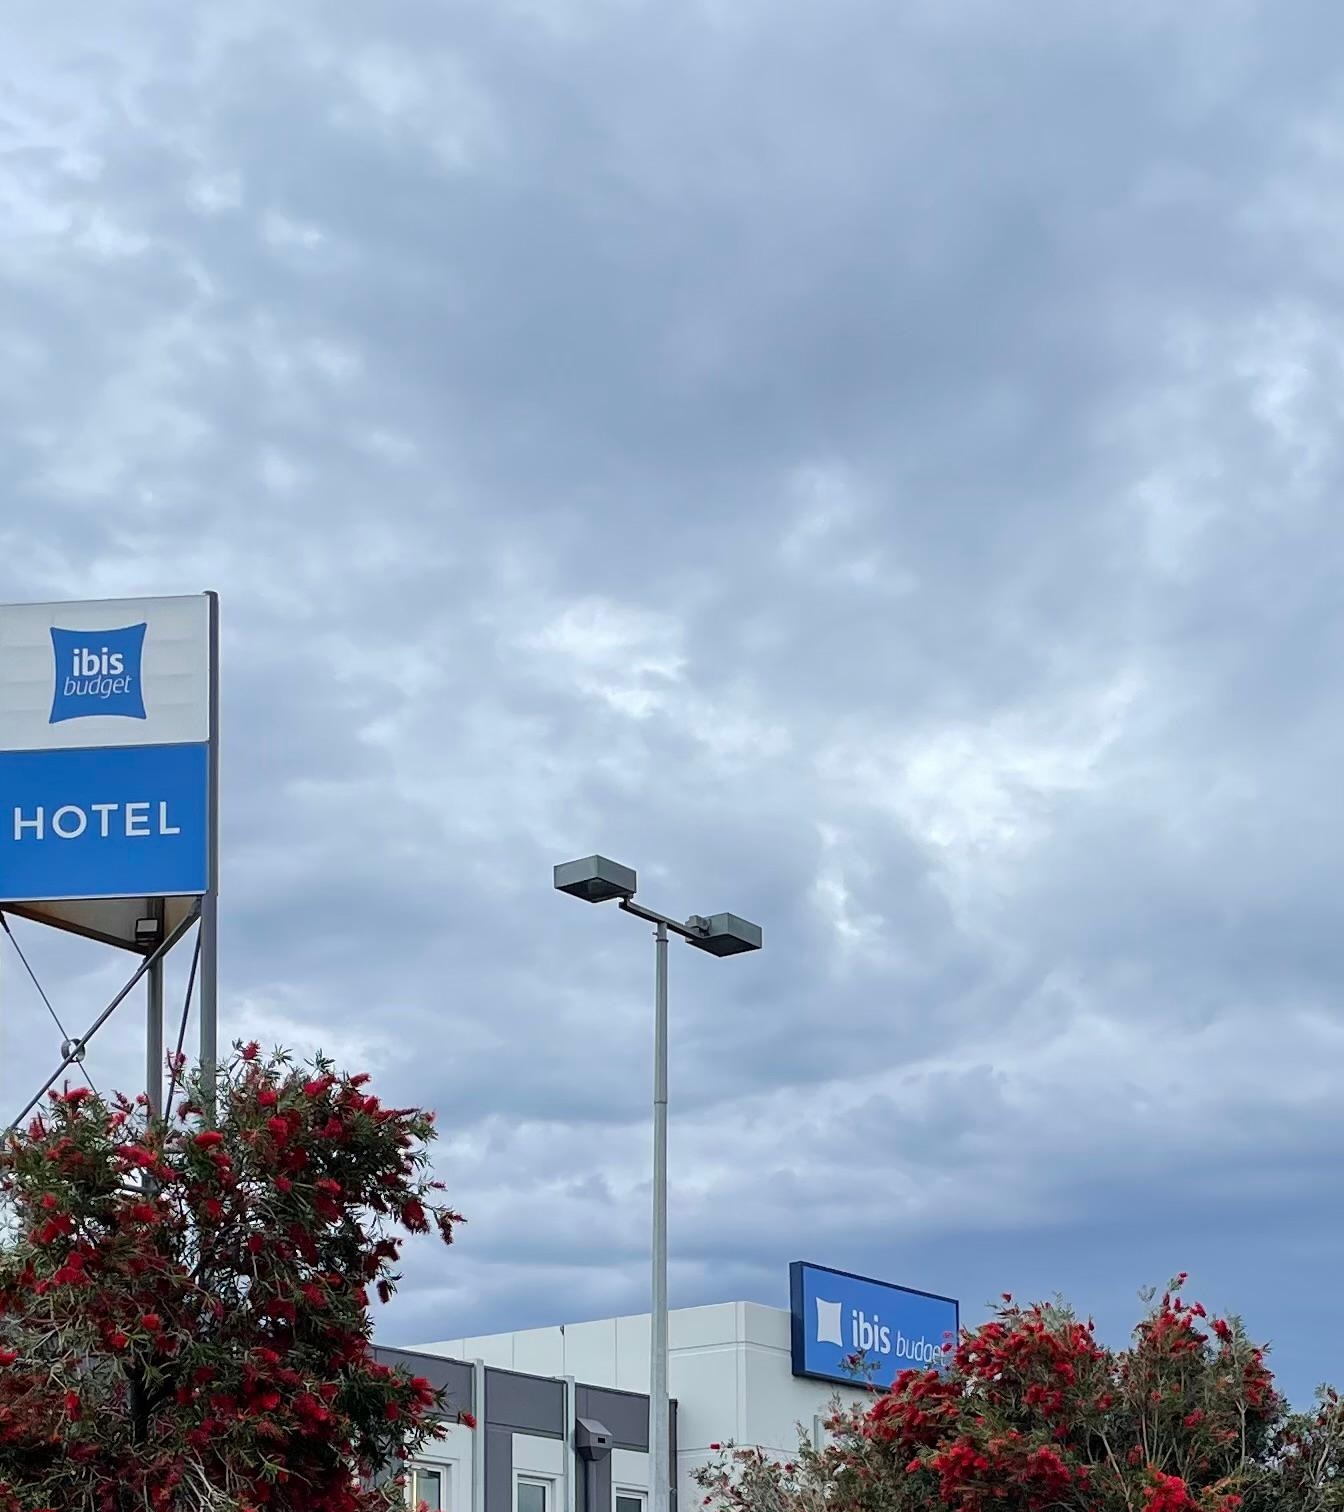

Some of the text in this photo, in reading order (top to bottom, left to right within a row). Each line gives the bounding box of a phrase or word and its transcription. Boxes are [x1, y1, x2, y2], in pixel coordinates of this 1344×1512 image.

[72, 647, 124, 677] ibis
[63, 674, 132, 699] budget
[14, 801, 181, 841] HOTEL
[852, 1309, 891, 1354] ibis
